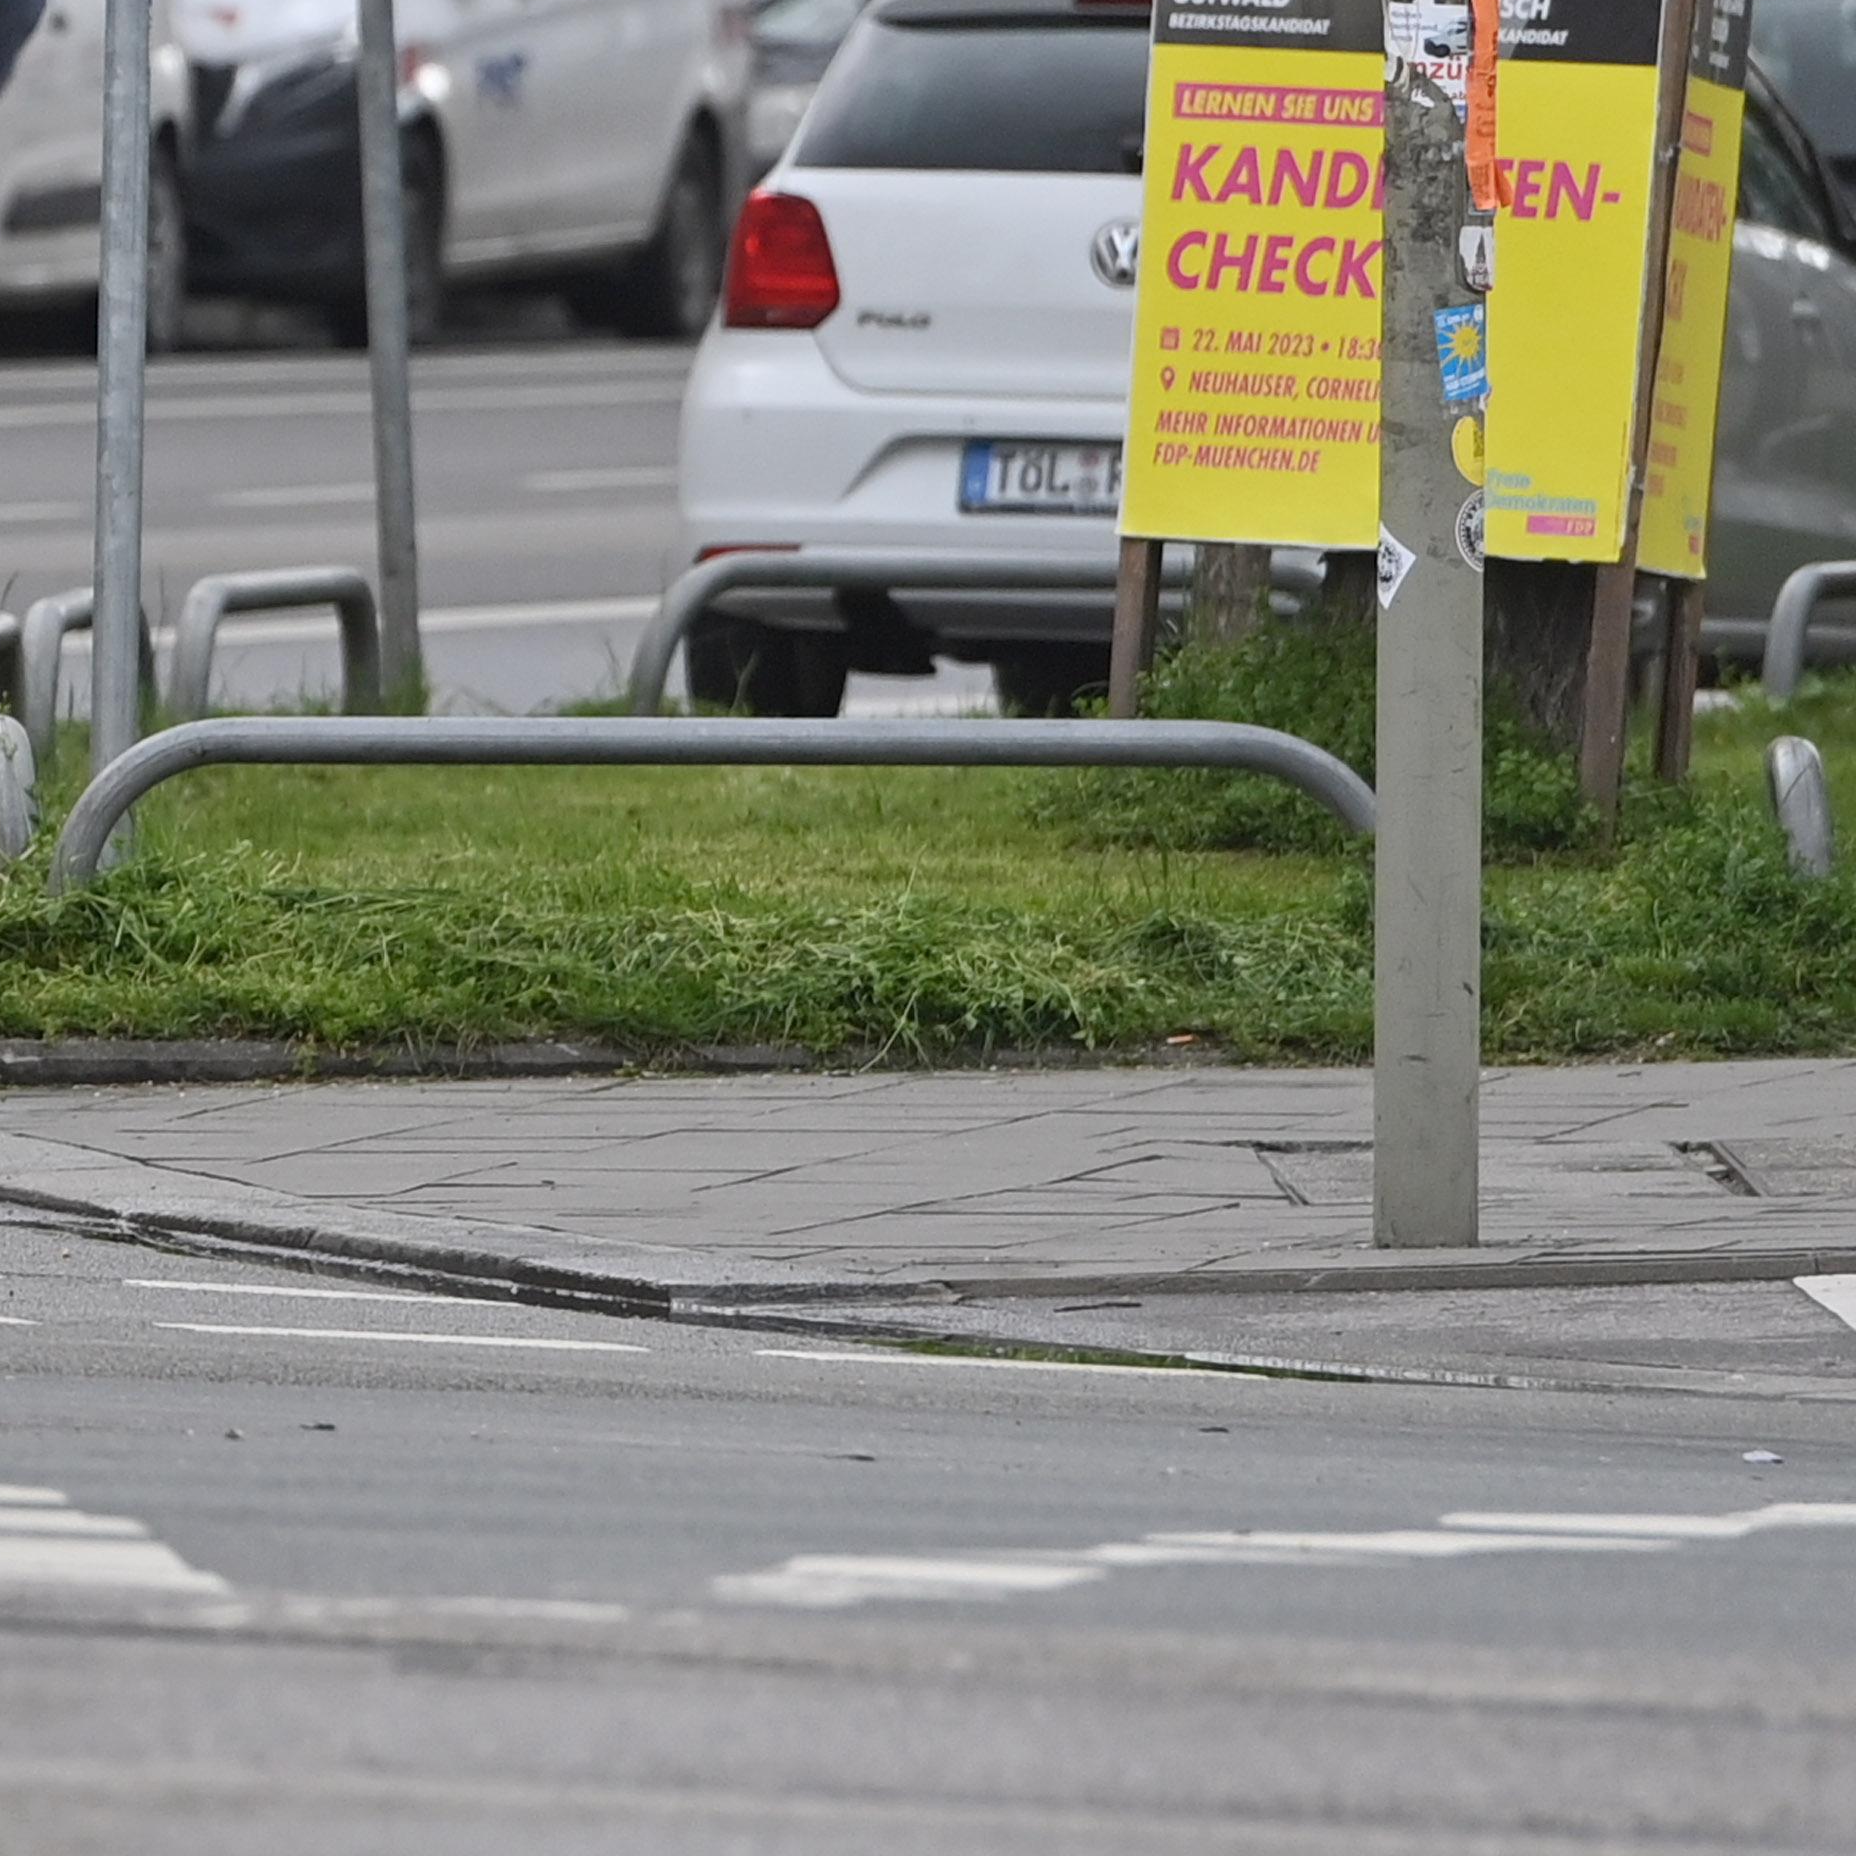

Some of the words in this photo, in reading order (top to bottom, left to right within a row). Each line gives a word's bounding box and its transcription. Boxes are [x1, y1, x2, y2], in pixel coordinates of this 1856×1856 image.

[1168, 11, 1332, 36] BEZIRKSTAGSKANDIDAT
[1498, 28, 1570, 47] KANDIDAT
[1180, 88, 1276, 117] LERNEN
[1281, 93, 1315, 120] SIE
[1323, 94, 1376, 122] UNS
[1165, 229, 1383, 300] CHECK
[1192, 328, 1219, 353] 22.
[1224, 330, 1263, 354] MAI
[1267, 331, 1316, 356] 2023
[1188, 370, 1299, 401] NEUHAUSER,
[1306, 376, 1381, 402] CORNELI
[1154, 410, 1209, 435] MEHR
[1214, 413, 1365, 442] INFORMATIONEN
[1153, 442, 1322, 474] FDP-MUENCHEN.DE
